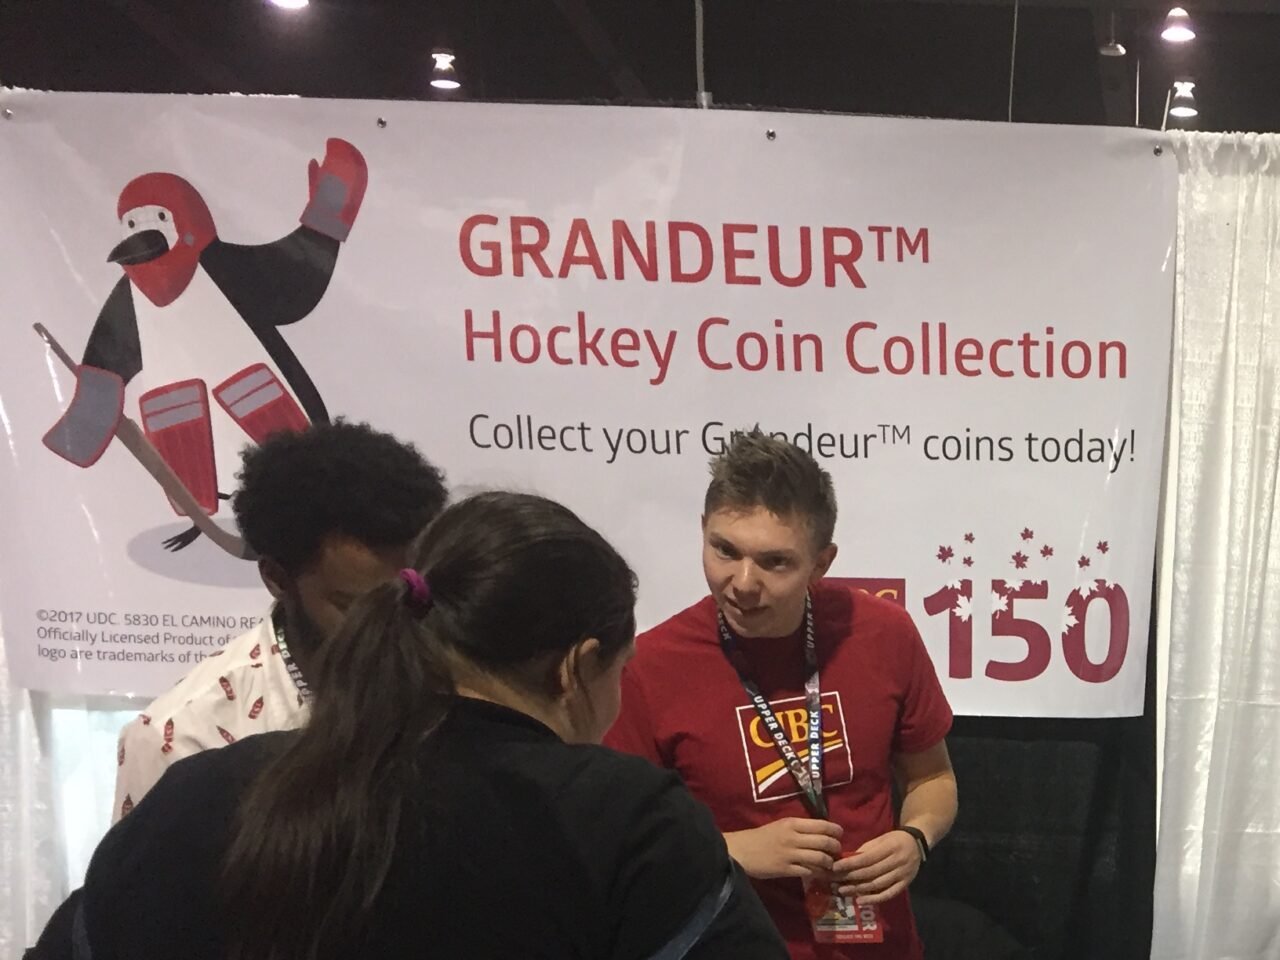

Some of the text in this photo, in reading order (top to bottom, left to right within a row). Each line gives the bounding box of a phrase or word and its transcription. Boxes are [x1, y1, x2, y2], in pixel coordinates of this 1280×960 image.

[464, 309, 1129, 386] Hockey Coin Collection
[469, 414, 592, 454] Collect
[603, 424, 690, 463] your
[923, 429, 1015, 463] coins
[1026, 428, 1137, 474] today!
[36, 609, 83, 624] ©2017
[124, 613, 159, 627] 5830
[162, 614, 178, 627] EL
[181, 614, 236, 629] CAMINO
[36, 626, 97, 645] Officially
[101, 631, 160, 644] Licensed
[163, 633, 213, 647] Product
[217, 634, 231, 646] of
[923, 578, 1130, 683] 150
[37, 644, 67, 662] logo
[70, 649, 93, 660] are
[97, 649, 175, 663] trademarks
[178, 650, 192, 663] of
[753, 695, 797, 760] UPPER DECK
[809, 710, 820, 778] UPPER DECK
